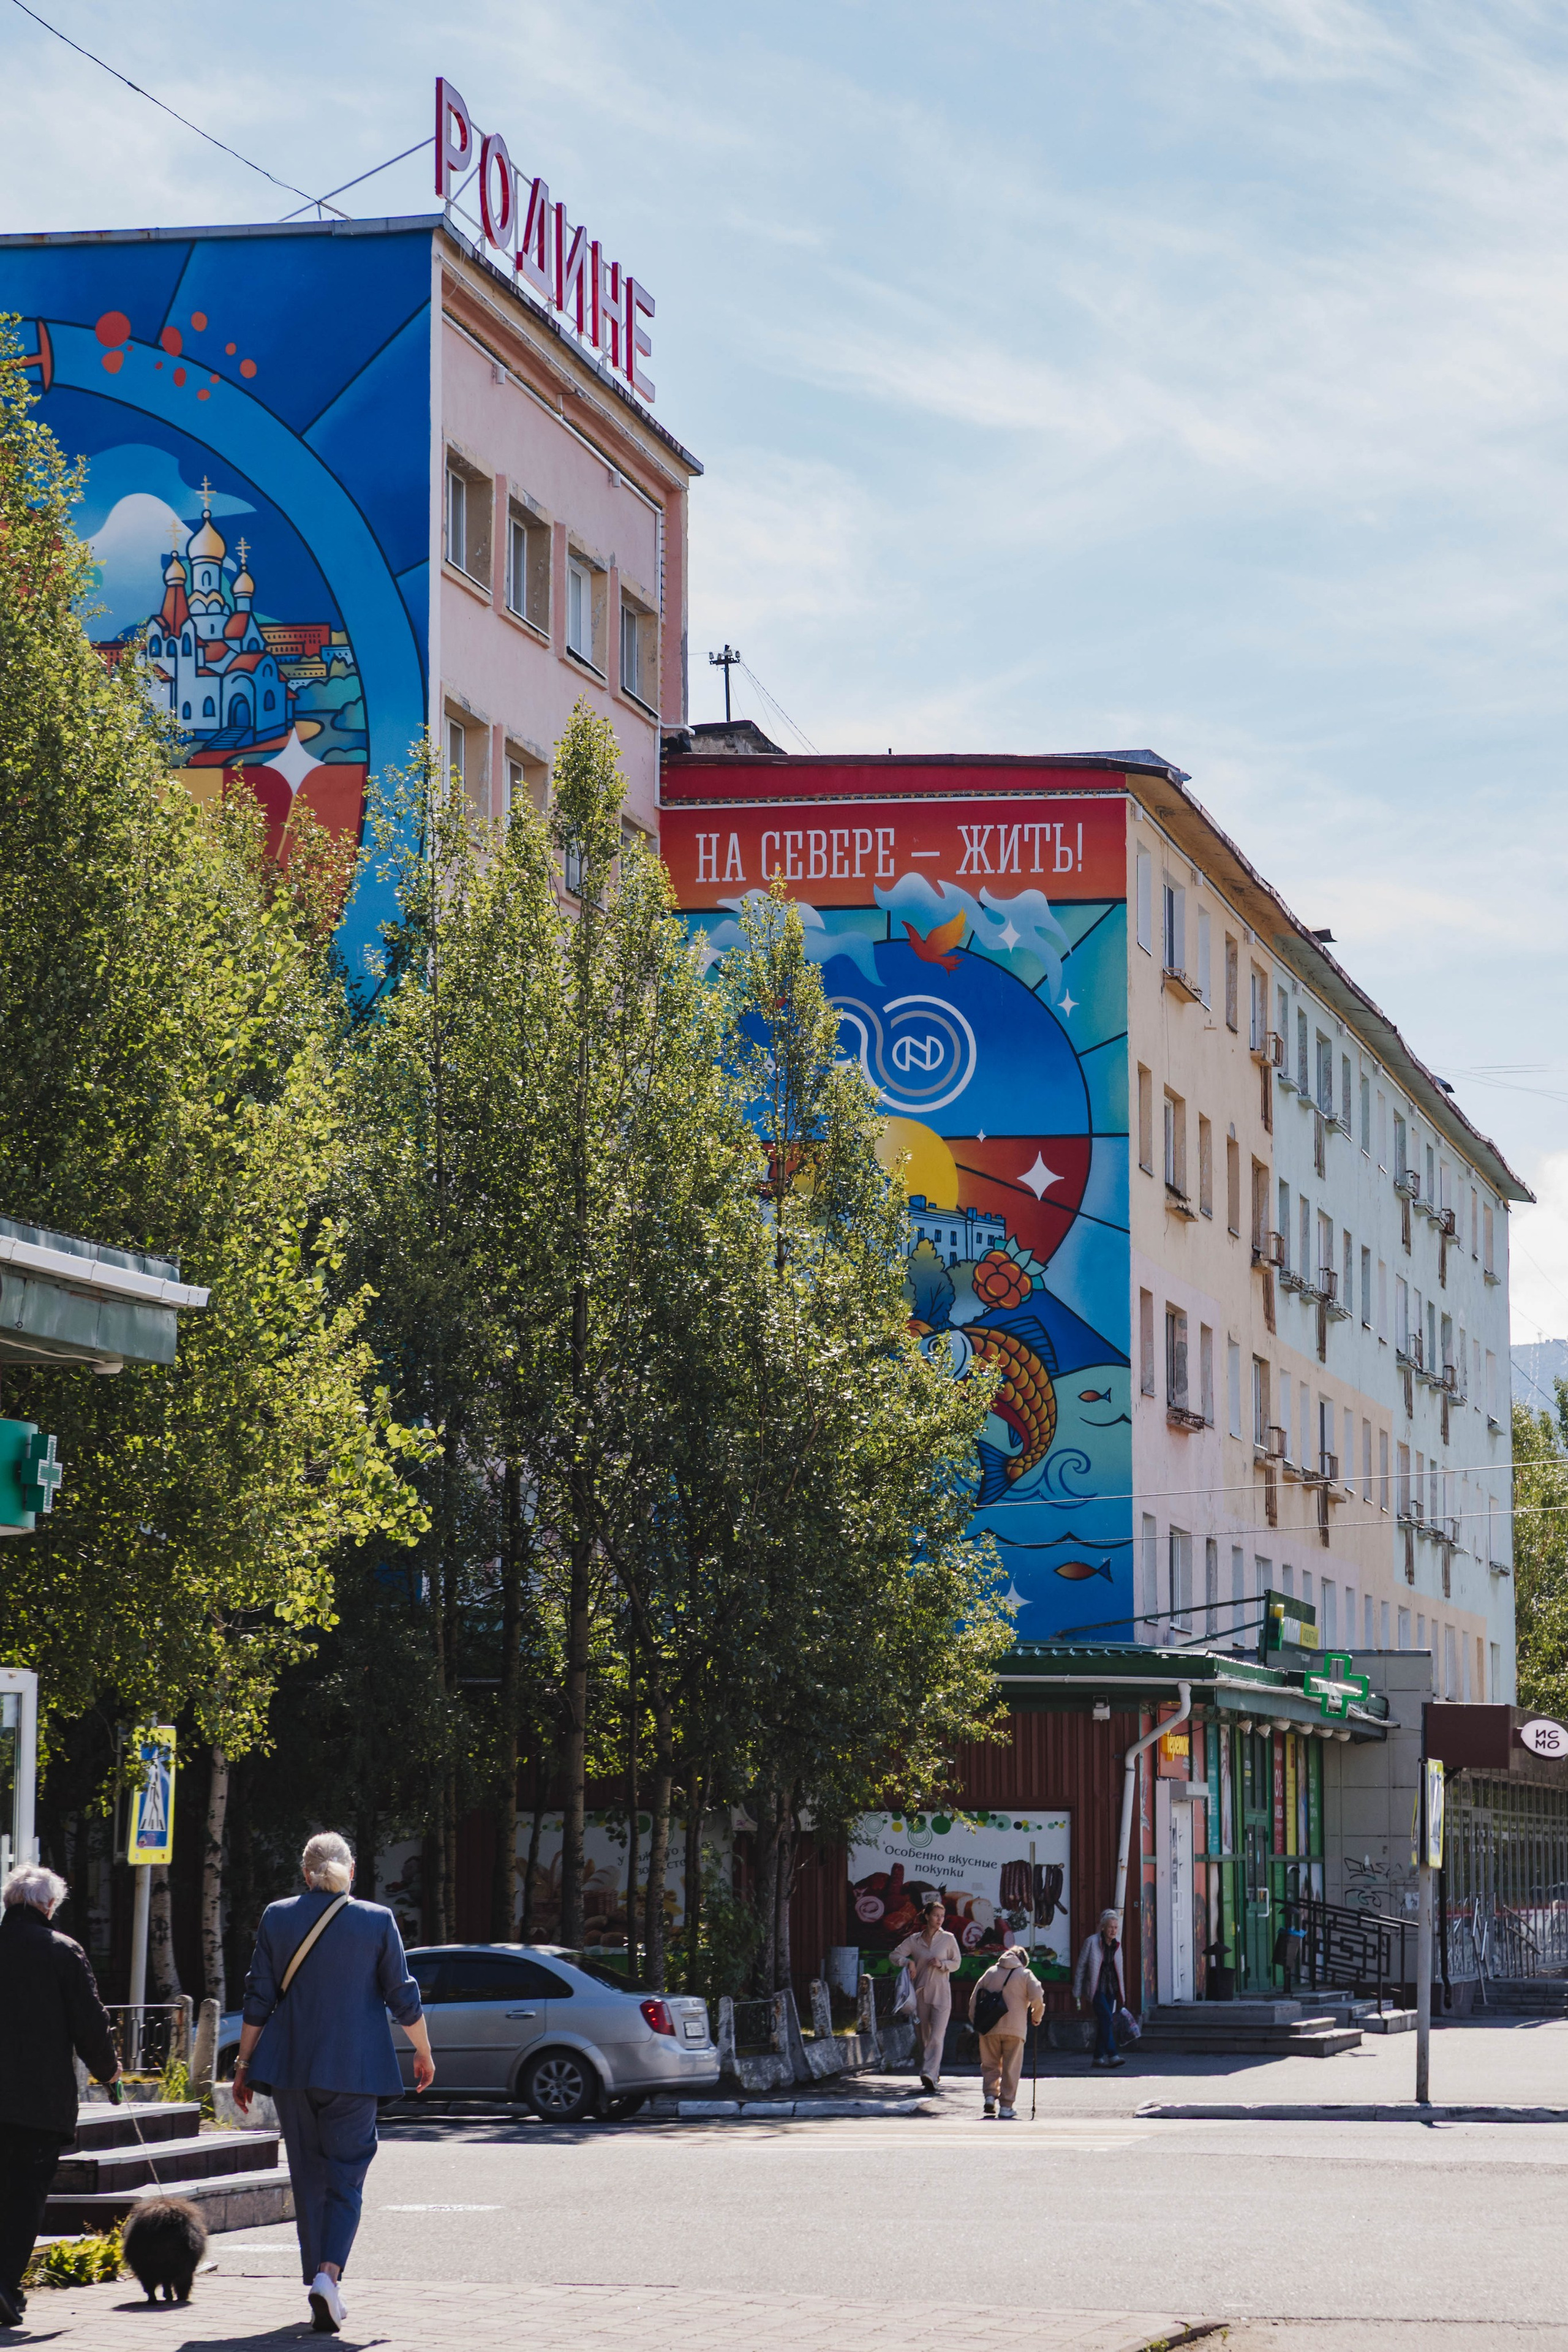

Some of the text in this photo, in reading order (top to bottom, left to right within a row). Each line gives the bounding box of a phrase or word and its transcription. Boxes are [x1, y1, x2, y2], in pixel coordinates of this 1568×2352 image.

[435, 77, 655, 403] РОДИНЕ
[696, 832, 746, 883] НА
[761, 827, 894, 881] СЕВЕРЕ
[956, 823, 1083, 875] ЖИТЬ!
[1535, 1740, 1560, 1749] МО
[884, 1845, 998, 1869] Особенно вкусные
[914, 1864, 965, 1877] покупки
